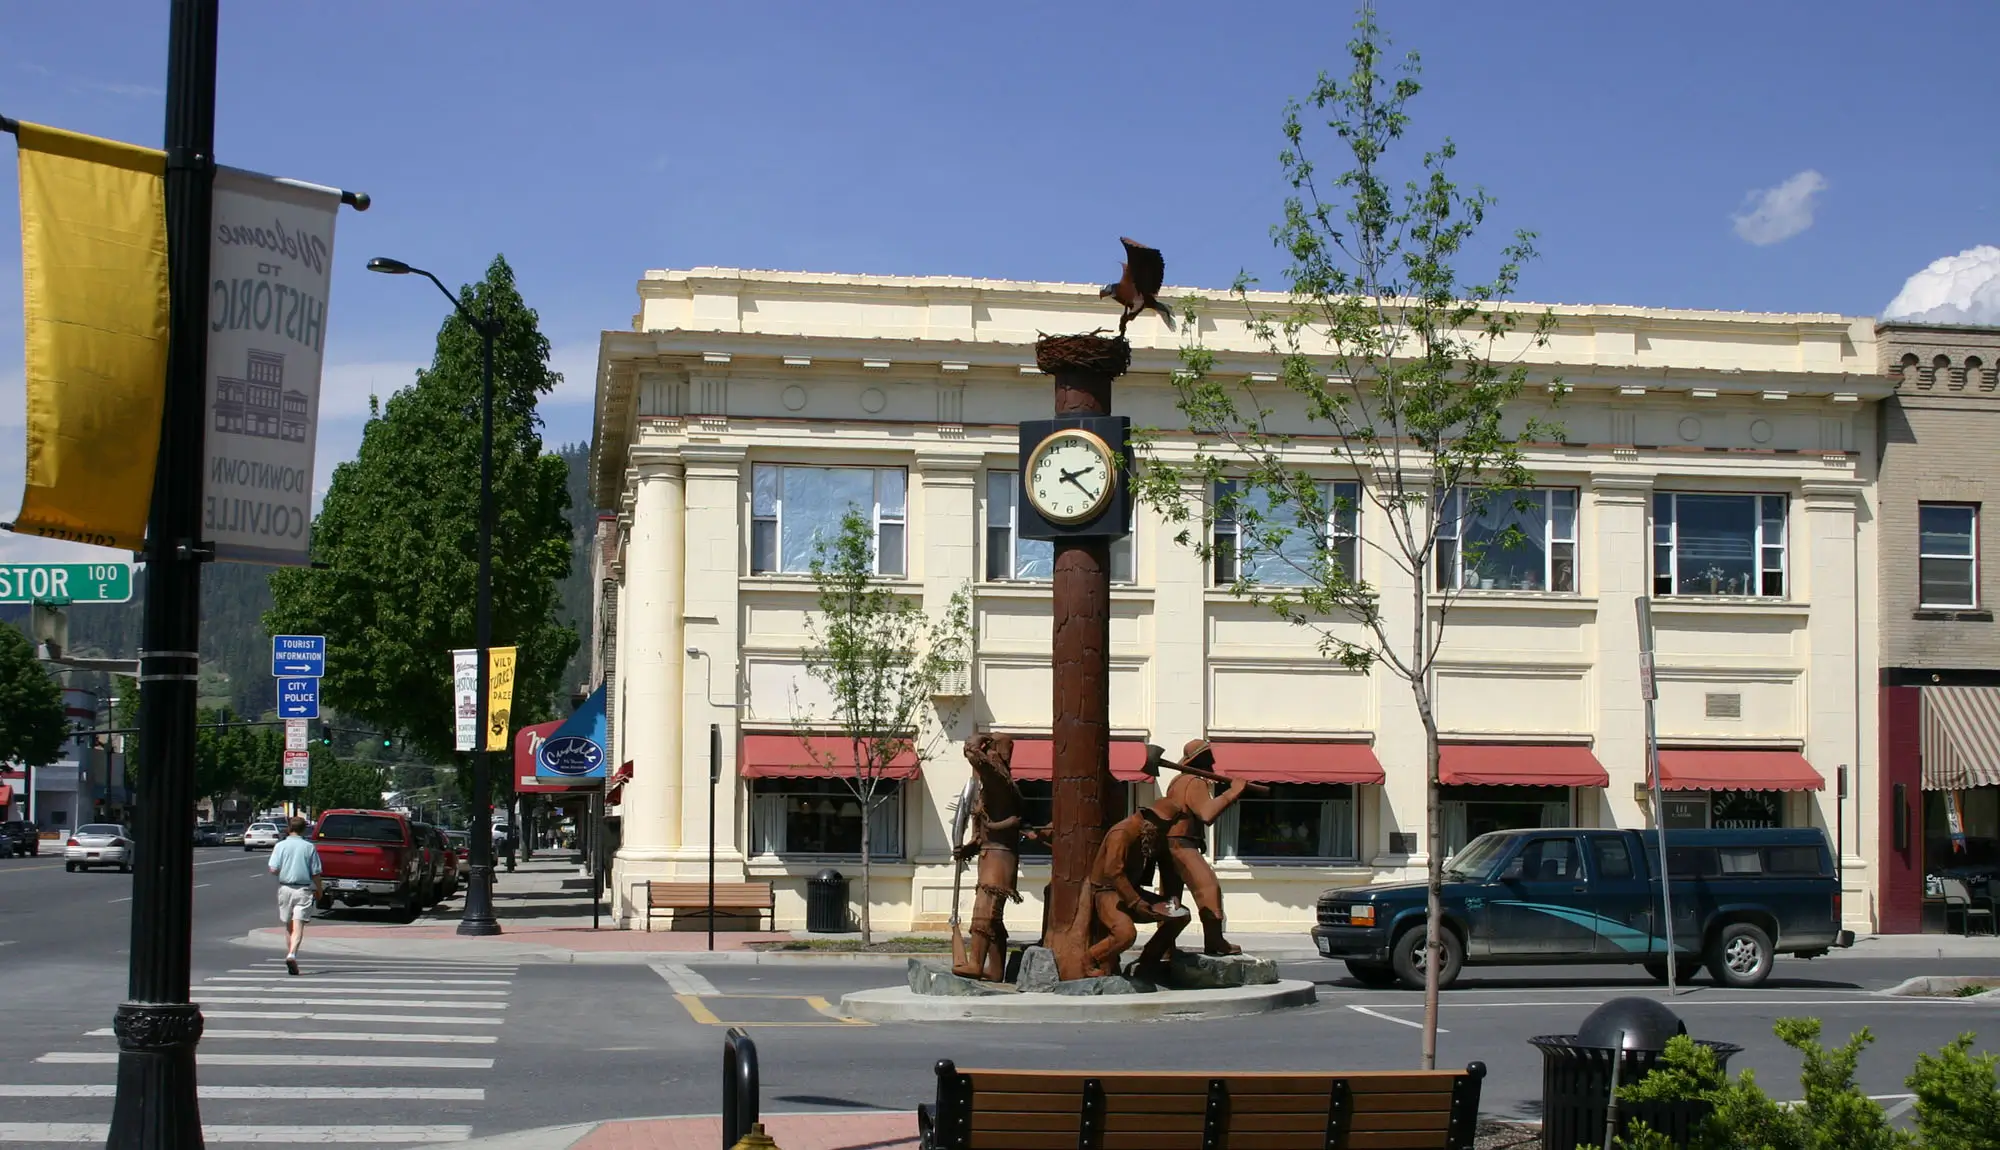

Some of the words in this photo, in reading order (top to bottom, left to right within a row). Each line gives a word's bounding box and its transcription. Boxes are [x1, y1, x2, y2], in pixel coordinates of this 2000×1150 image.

[1064, 440, 1078, 448] 12
[1085, 443, 1090, 452] 1
[1049, 446, 1060, 455] 11
[1039, 459, 1052, 468] 10
[1095, 455, 1102, 464] 2
[1034, 473, 1042, 482] 9
[1099, 471, 1106, 480] 3
[1039, 490, 1047, 498] 8
[1093, 487, 1100, 495] 4
[1052, 502, 1059, 510] 7
[1066, 505, 1074, 514] 6
[1082, 501, 1090, 509] 5
[88, 565, 118, 581] 100
[99, 583, 108, 599] E
[283, 640, 316, 649] TOURIST
[275, 651, 322, 661] INFORMATION
[494, 657, 512, 668] WILD
[490, 667, 514, 690] TURKEY
[288, 682, 307, 691] CITY
[284, 693, 315, 702] POLICE
[493, 691, 511, 700] DAZE
[1713, 792, 1737, 816] OLD
